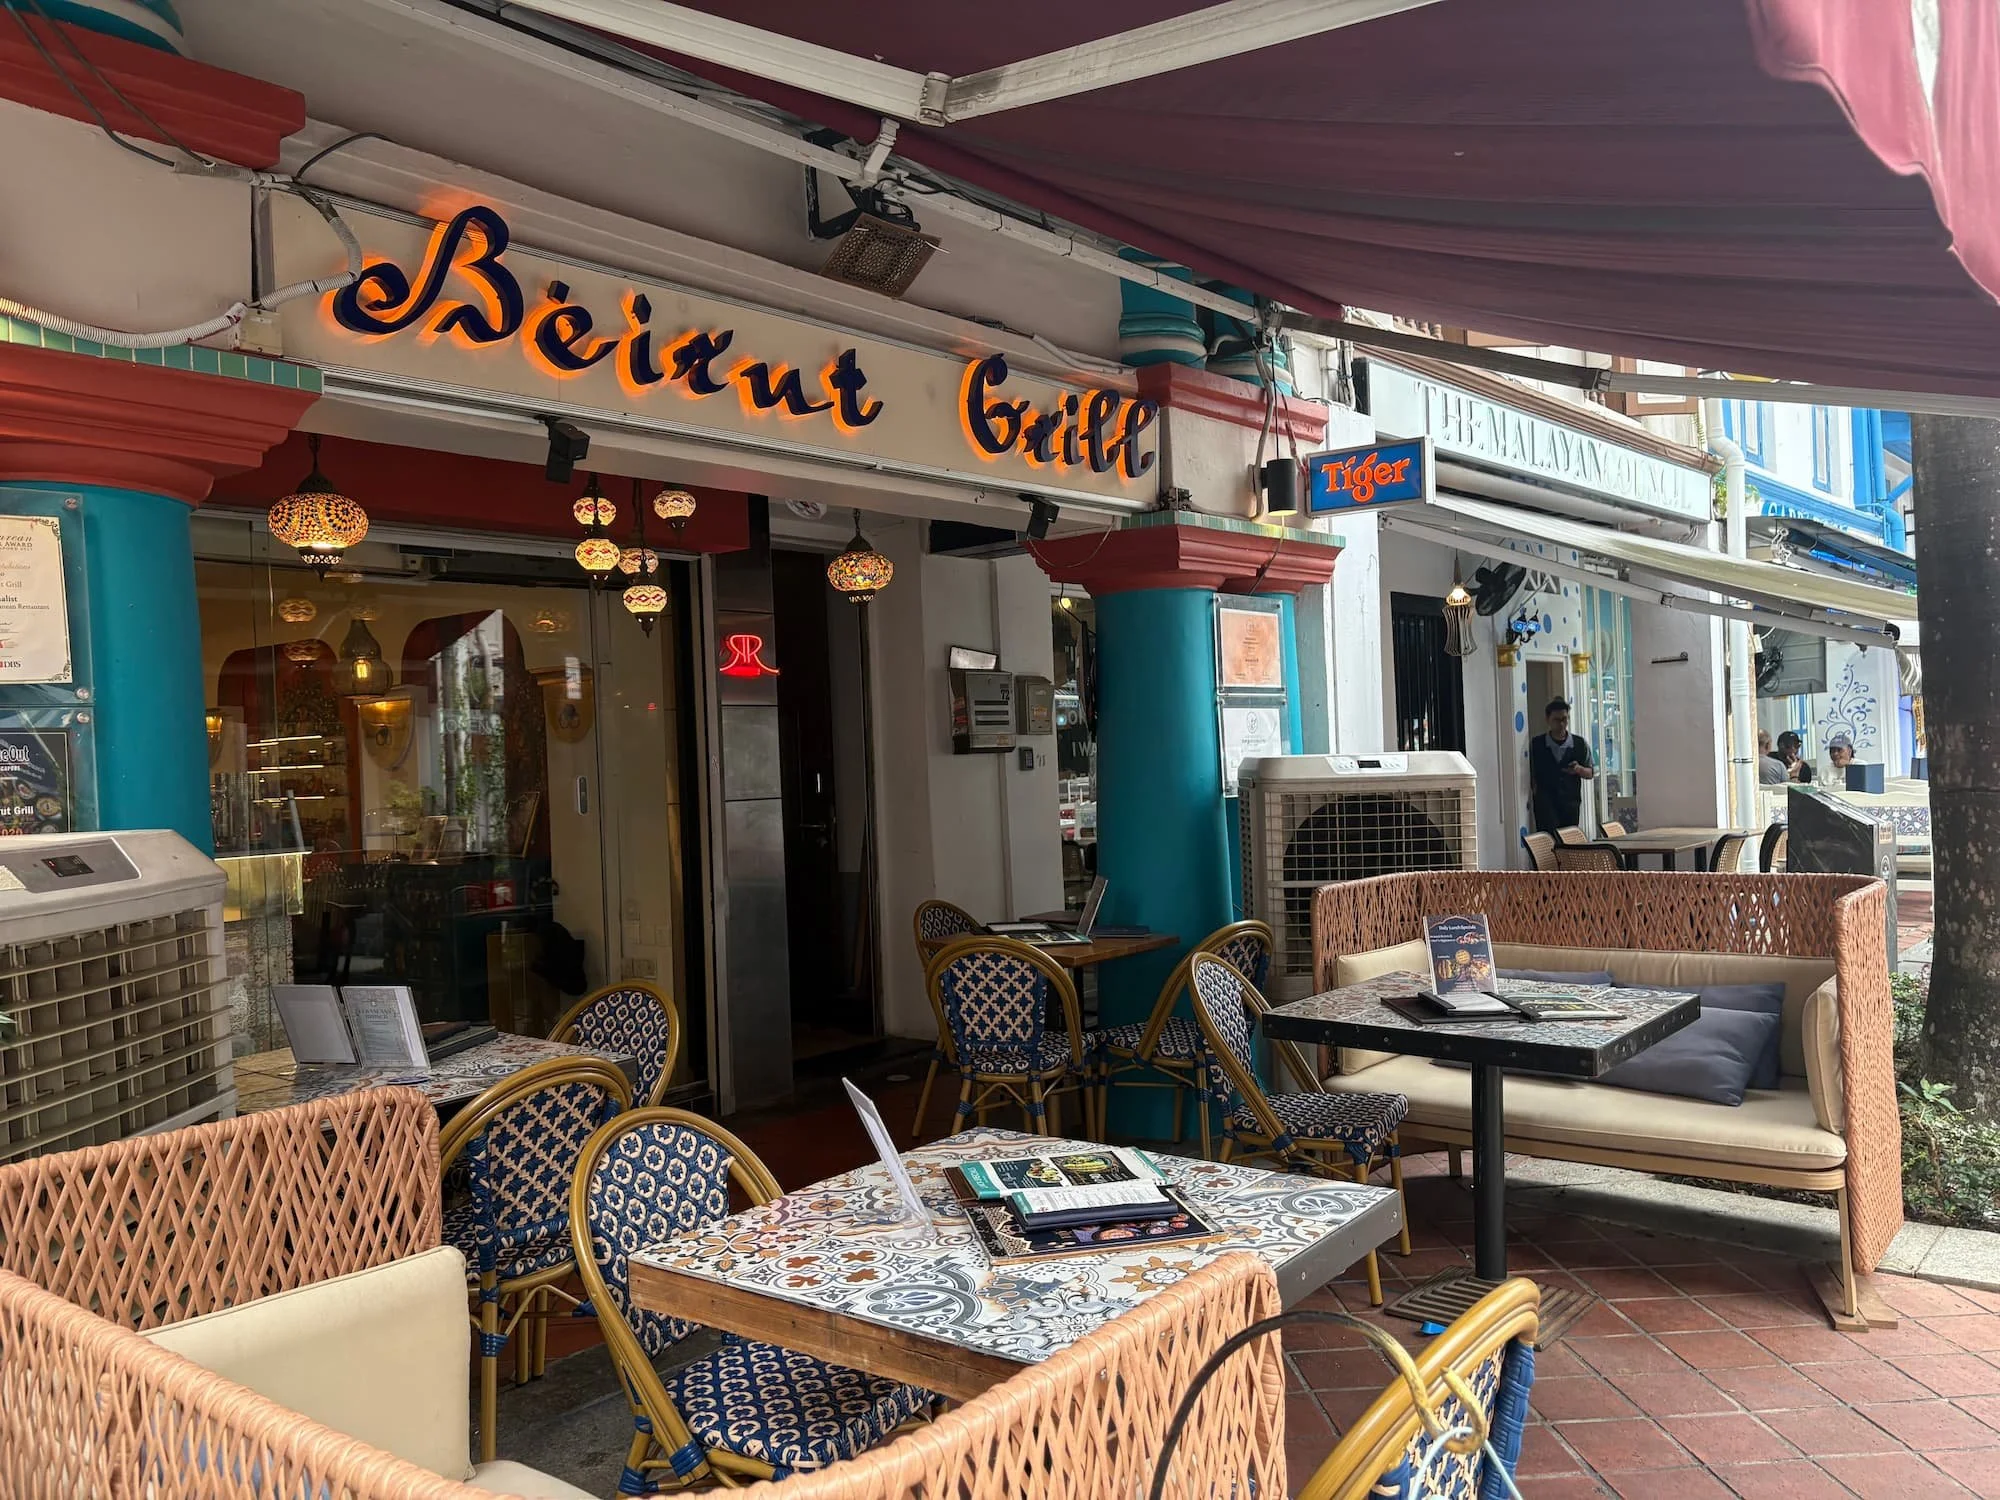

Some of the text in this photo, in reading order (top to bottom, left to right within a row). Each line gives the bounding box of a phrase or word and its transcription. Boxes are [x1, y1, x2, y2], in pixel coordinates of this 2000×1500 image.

[332, 205, 1159, 480] Beirut Grill
[1413, 380, 1485, 449] THE
[1486, 405, 1604, 484] MALAYAN
[1320, 452, 1412, 503] Tiger
[13, 805, 34, 815] Grill
